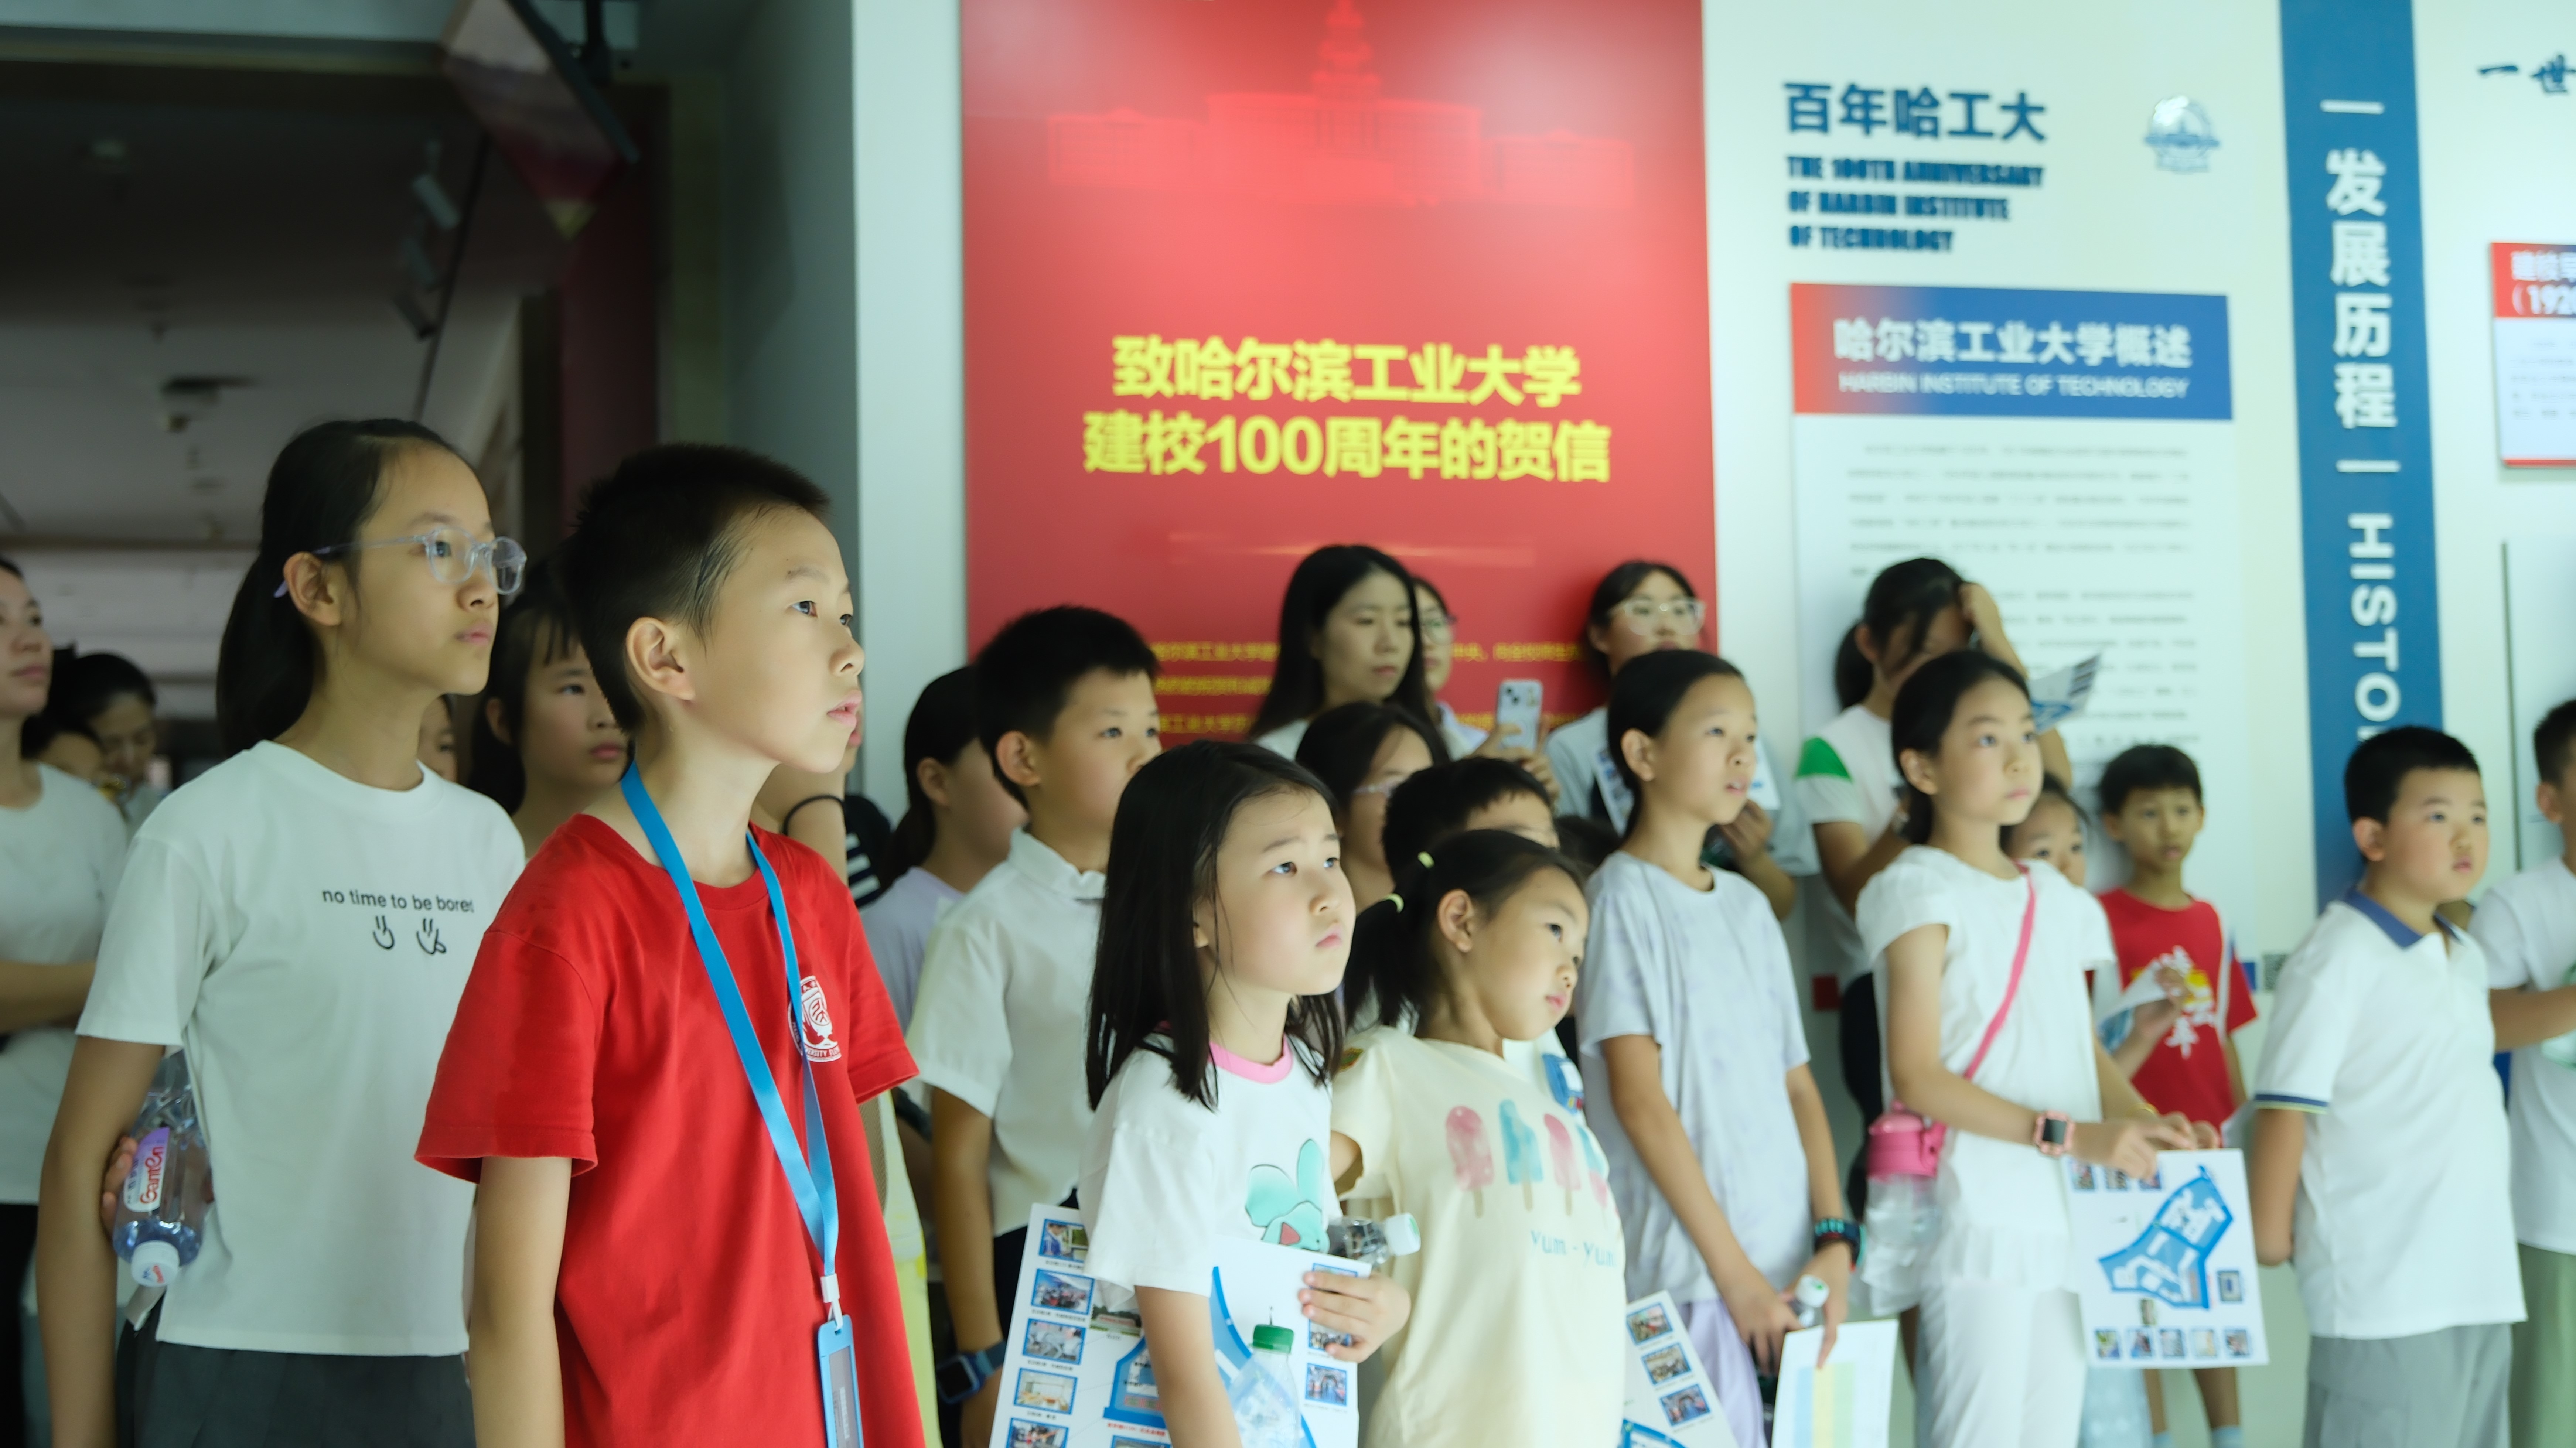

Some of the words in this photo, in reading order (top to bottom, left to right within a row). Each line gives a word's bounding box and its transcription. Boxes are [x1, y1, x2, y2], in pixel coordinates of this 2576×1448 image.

[1784, 83, 2047, 143] 百年哈工大
[2324, 148, 2397, 429] 发展历程
[1113, 335, 1582, 409] 致哈尔滨工业大学
[1833, 316, 2193, 369] 哈尔滨工业大学概述
[1838, 371, 1917, 394] HARBIN
[1921, 372, 2023, 396] INSTITUTE
[2024, 374, 2053, 396] OF
[2058, 375, 2190, 399] TECHNOLOGY
[1084, 411, 1611, 482] 建校100周年的贺信
[2348, 513, 2401, 741] HISTO
[322, 889, 344, 904] no
[349, 889, 387, 908] time
[391, 894, 407, 909] to
[412, 894, 432, 911] be
